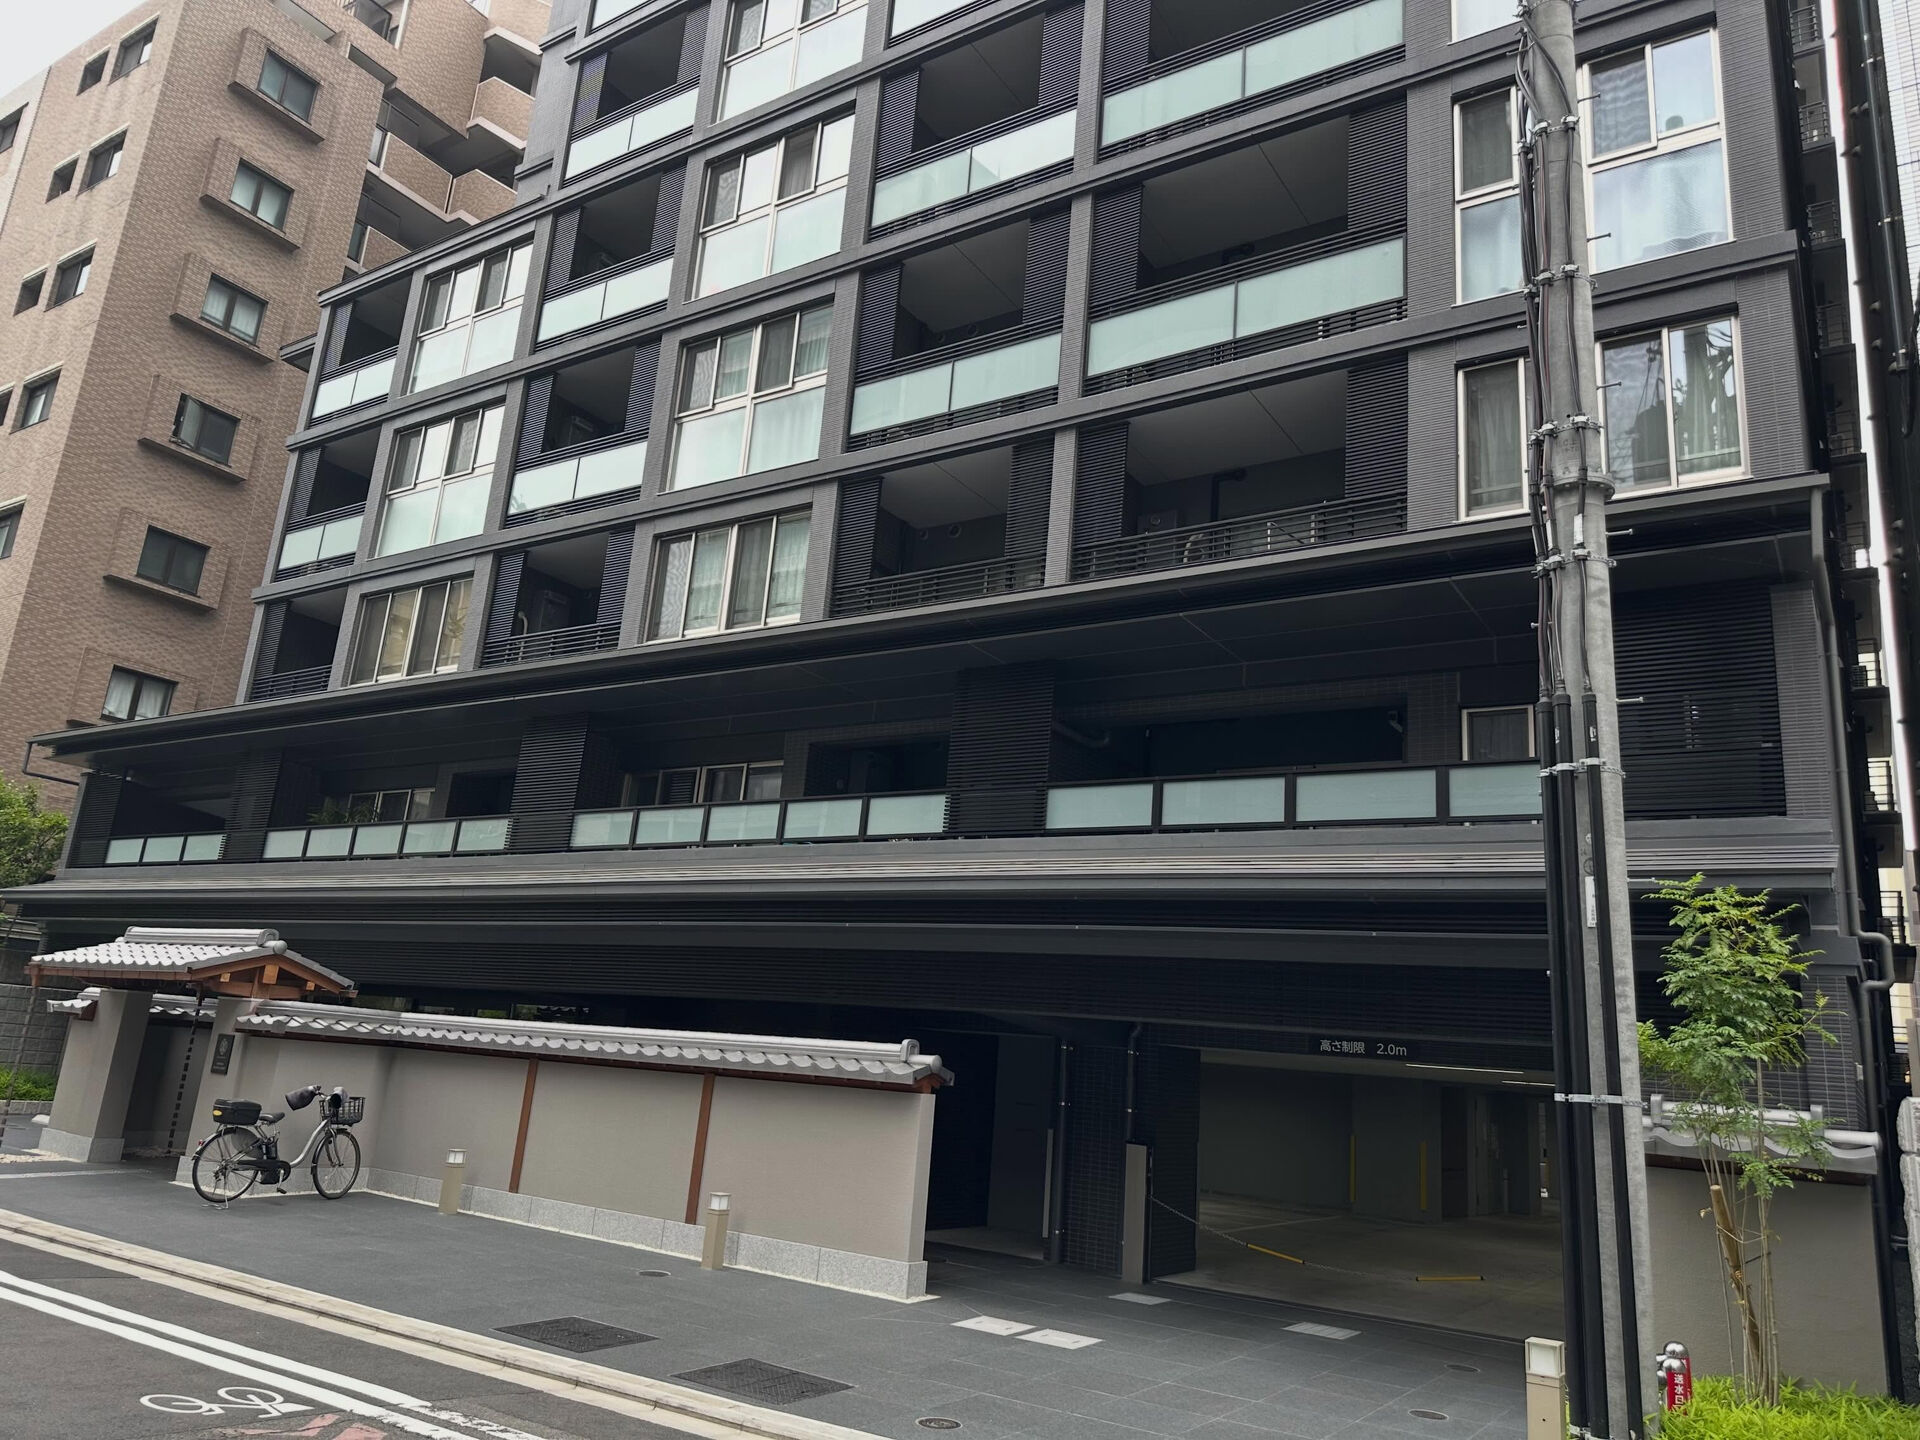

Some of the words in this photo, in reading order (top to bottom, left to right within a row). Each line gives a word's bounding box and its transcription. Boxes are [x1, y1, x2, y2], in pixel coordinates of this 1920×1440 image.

[1320, 1039, 1366, 1054] 高さ制限
[1376, 1043, 1407, 1056] 2.0m
